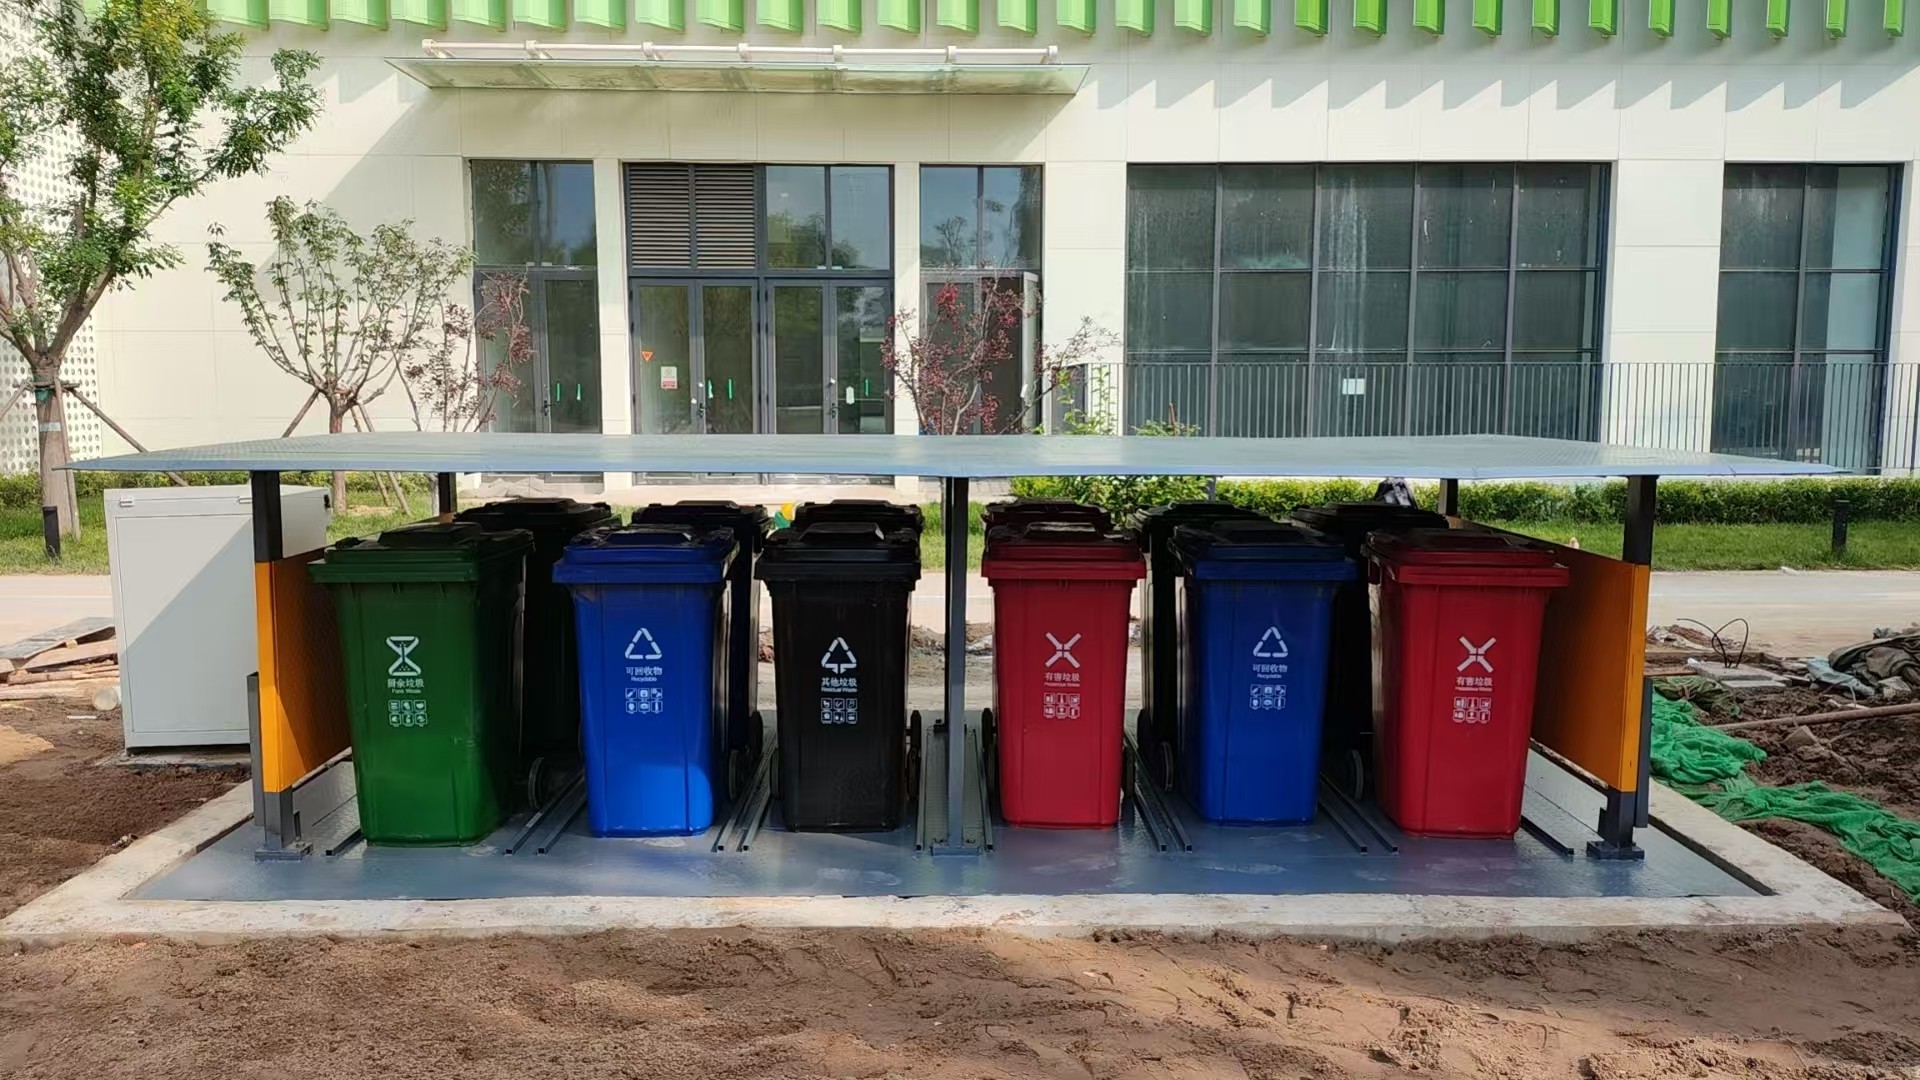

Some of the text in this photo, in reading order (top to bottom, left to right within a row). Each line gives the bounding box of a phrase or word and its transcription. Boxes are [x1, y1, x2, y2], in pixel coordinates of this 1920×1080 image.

[625, 666, 663, 676] 可回收物
[1252, 664, 1288, 673] 可回收物
[821, 677, 857, 687] 其他垃圾
[1044, 672, 1080, 682] 有害垃圾
[1456, 676, 1492, 686] 有害垃圾
